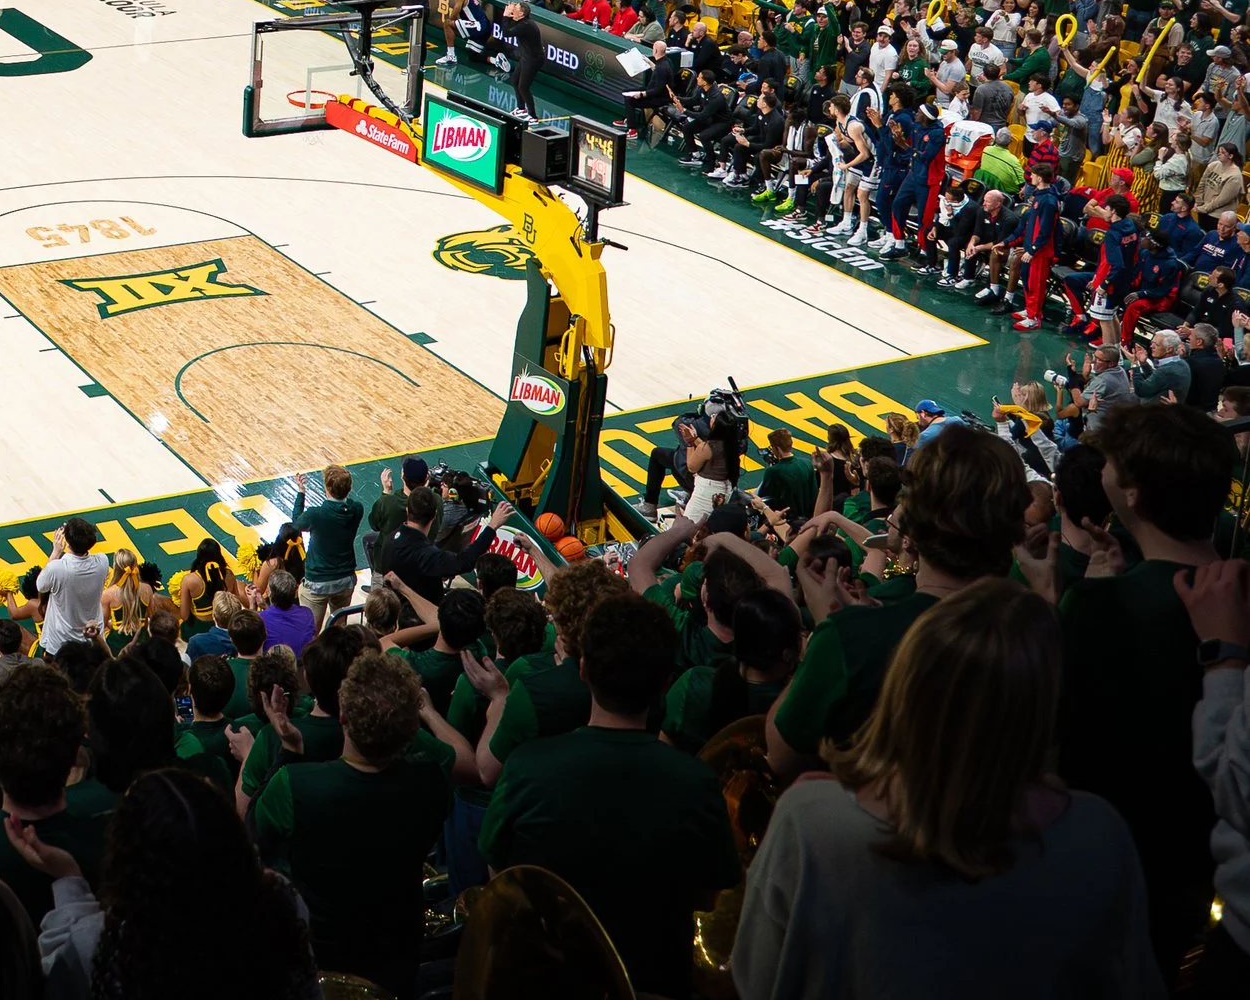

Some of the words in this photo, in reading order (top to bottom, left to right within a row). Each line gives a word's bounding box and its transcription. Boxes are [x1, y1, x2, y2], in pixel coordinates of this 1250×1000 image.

[547, 44, 579, 70] DEED
[432, 120, 486, 152] LIBMAN
[25, 215, 157, 249] 1845
[523, 213, 536, 245] BU
[511, 377, 561, 407] LIBMAN
